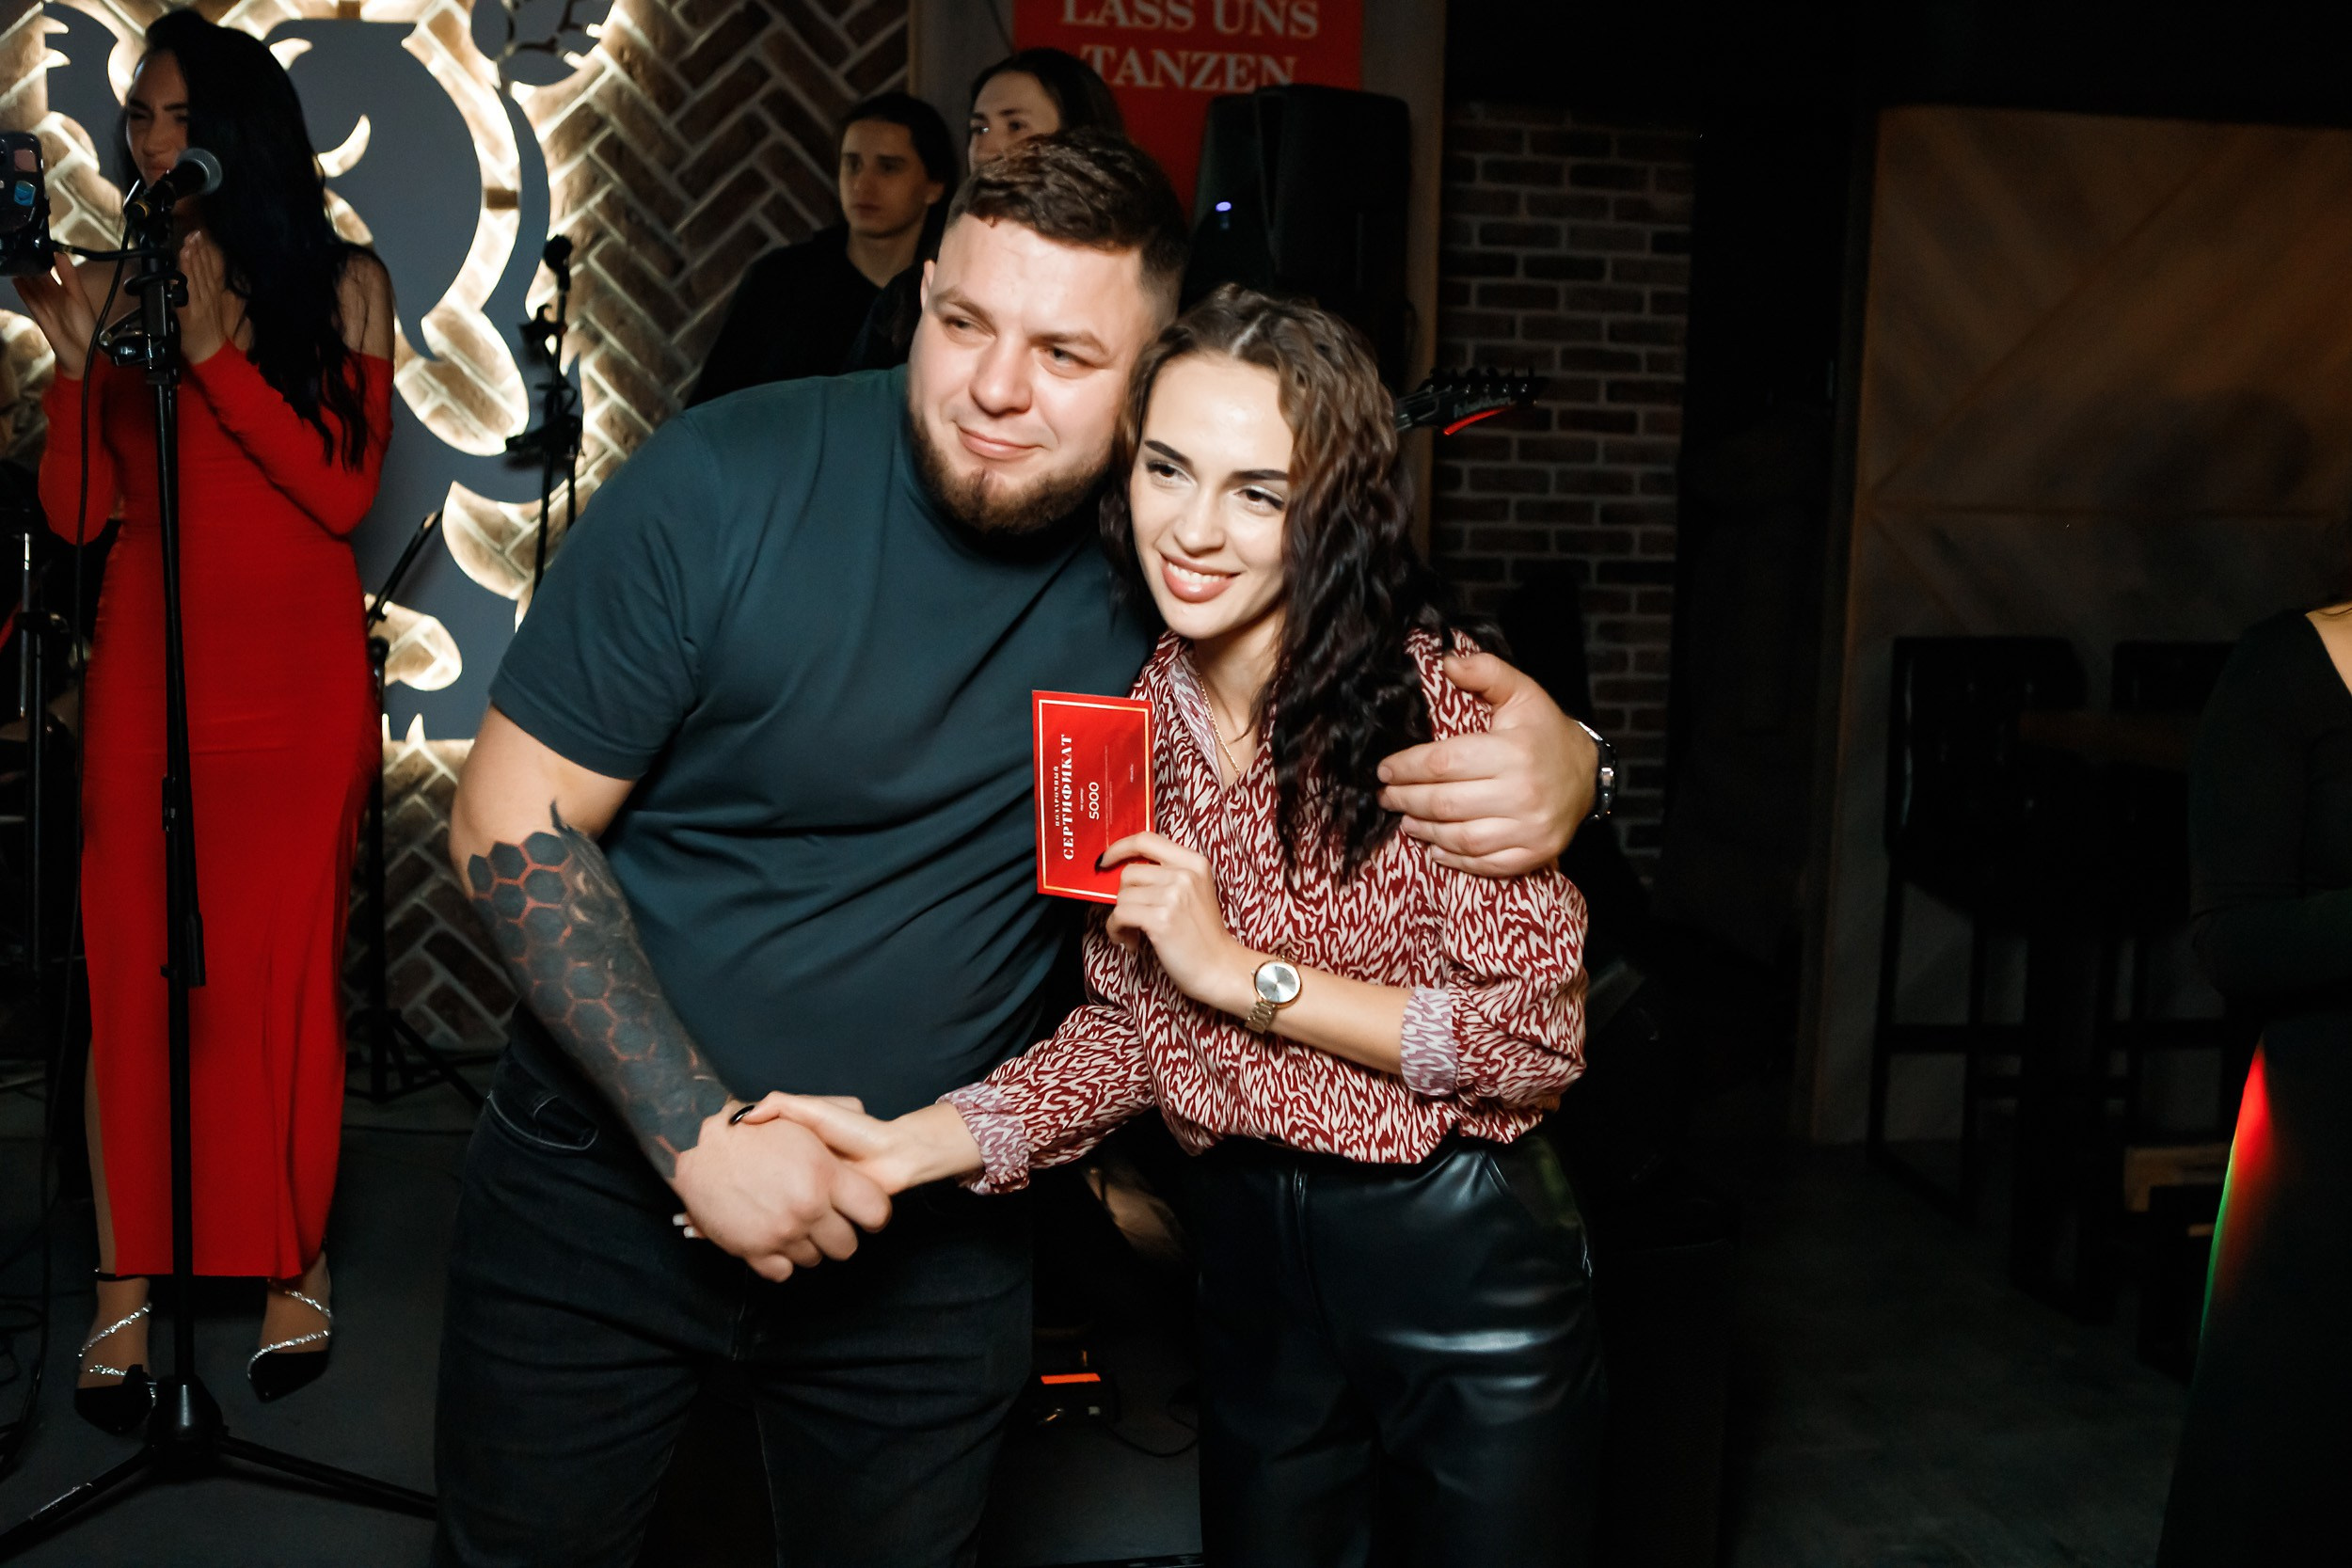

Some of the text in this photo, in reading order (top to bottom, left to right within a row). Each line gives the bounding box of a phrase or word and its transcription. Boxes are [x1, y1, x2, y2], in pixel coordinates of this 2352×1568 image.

[1059, 0, 1319, 40] LASS UNS
[1081, 43, 1297, 94] TANZEN
[1061, 735, 1074, 860] СЕРТИФИКАТ
[1089, 782, 1100, 820] 5000
